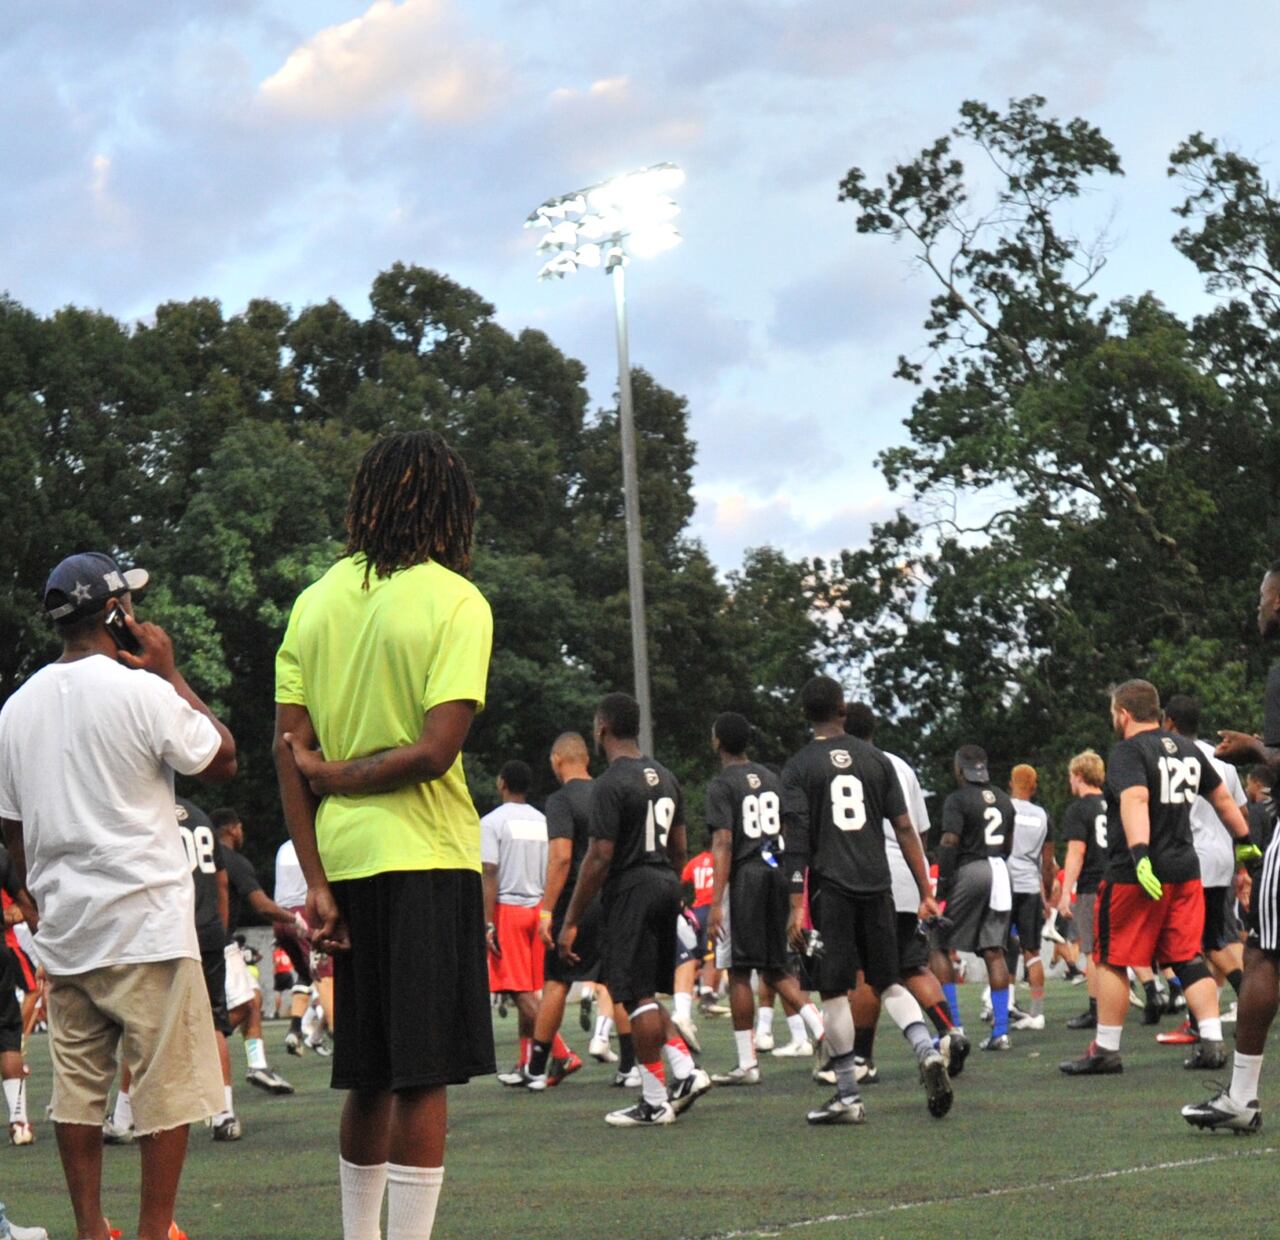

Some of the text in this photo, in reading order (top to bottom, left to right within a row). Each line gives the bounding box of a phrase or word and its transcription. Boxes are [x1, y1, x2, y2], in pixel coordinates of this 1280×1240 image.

[830, 774, 867, 831] 8
[1158, 756, 1201, 803] 129
[646, 797, 675, 851] 19
[742, 791, 781, 838] 88
[983, 807, 1005, 845] 2
